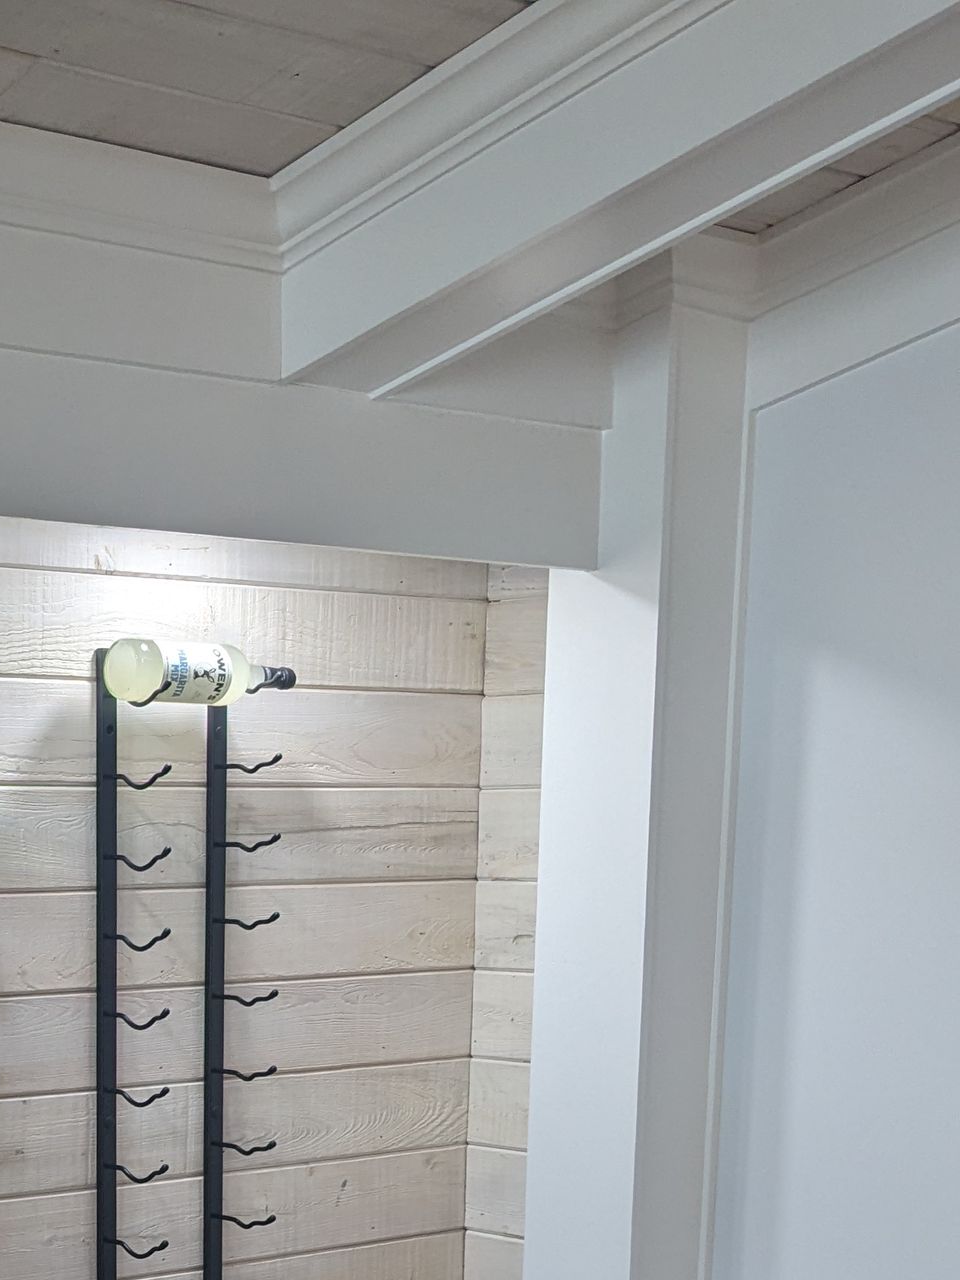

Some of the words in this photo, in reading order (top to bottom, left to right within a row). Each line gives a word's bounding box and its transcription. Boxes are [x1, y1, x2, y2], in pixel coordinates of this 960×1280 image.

[171, 665, 179, 682] MIX
[172, 649, 188, 697] MARGARITA
[208, 649, 226, 700] OWEN'S
